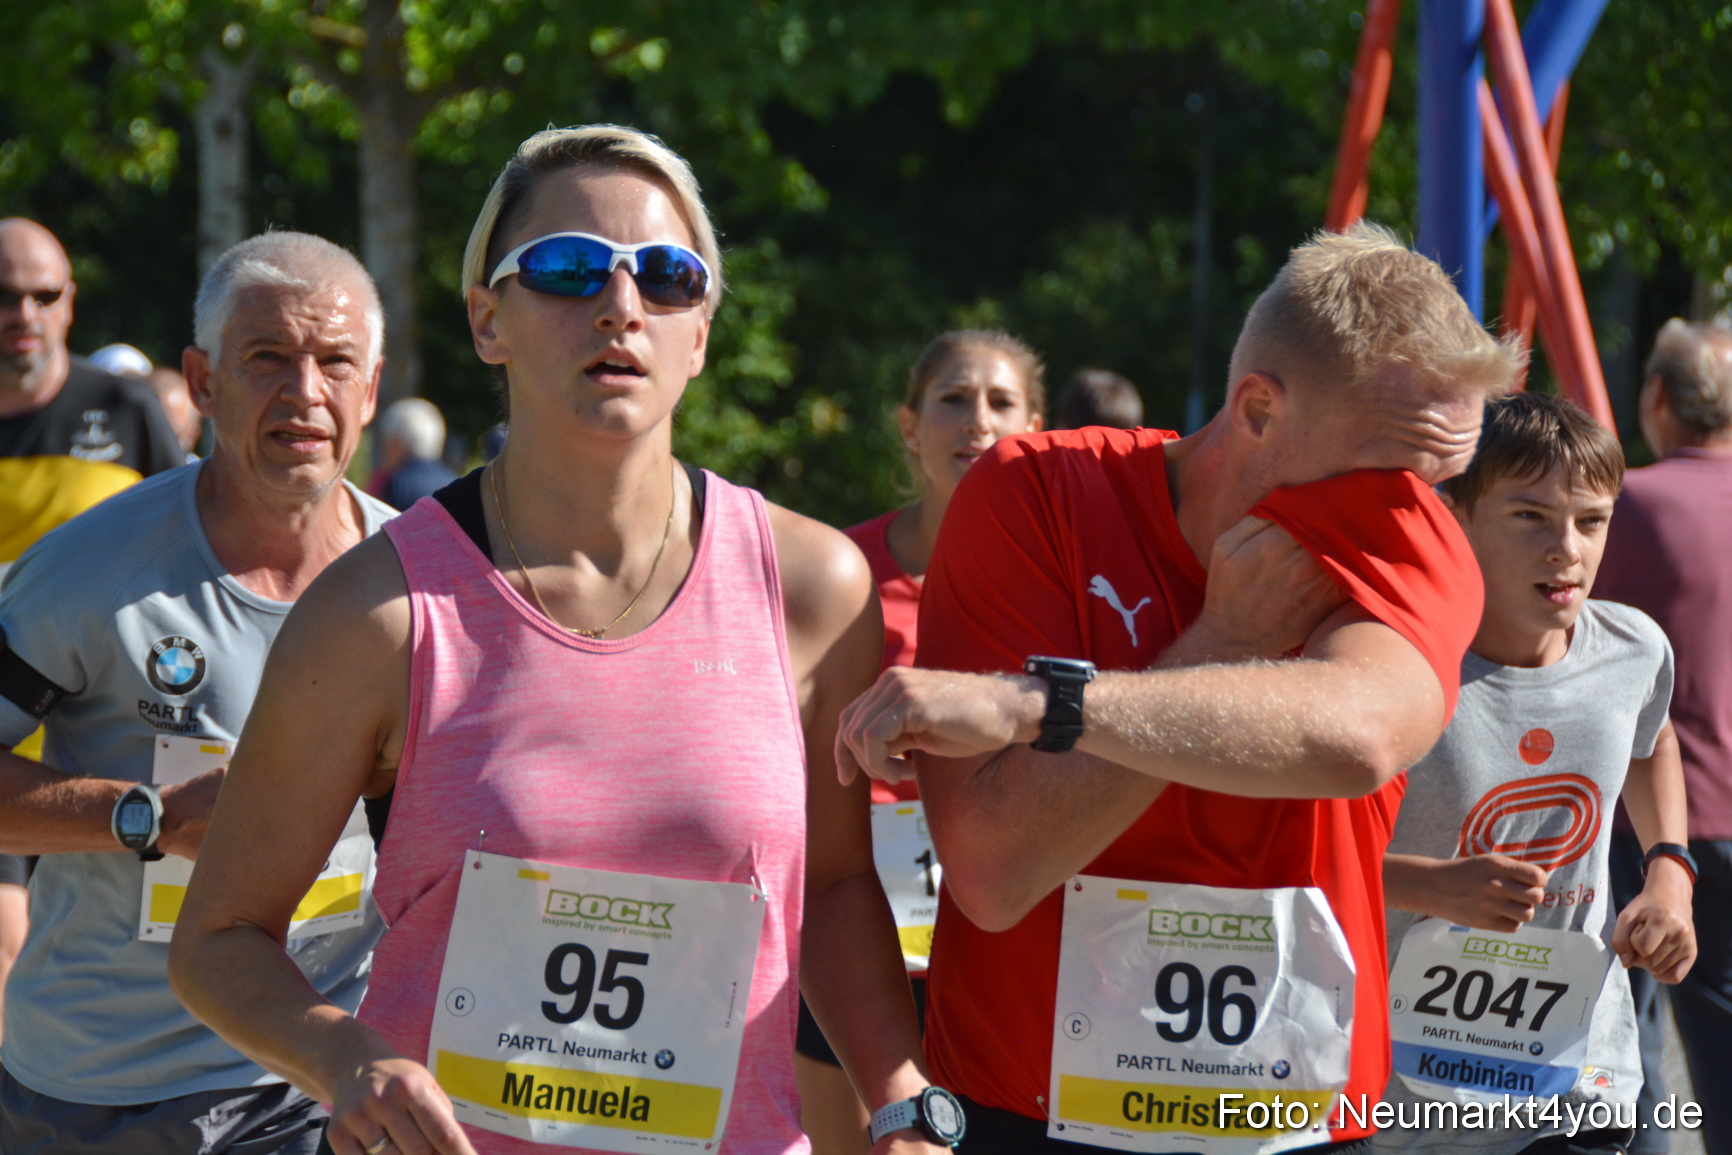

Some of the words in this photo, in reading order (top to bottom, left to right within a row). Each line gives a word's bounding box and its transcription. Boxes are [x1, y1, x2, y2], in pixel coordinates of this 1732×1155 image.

[153, 637, 204, 659] BMW
[138, 699, 198, 722] PARTL
[545, 888, 676, 930] BOCK
[1542, 883, 1596, 908] eisla
[542, 915, 582, 929] inspired
[584, 921, 595, 931] by
[598, 923, 626, 934] smart
[629, 927, 672, 940] concepts
[1148, 909, 1274, 942] BOCK
[1147, 937, 1185, 948] inspired
[1187, 939, 1198, 950] by
[1201, 942, 1229, 951] smart
[1232, 943, 1275, 953] concepts
[1463, 937, 1552, 965] BOCK
[541, 942, 649, 1030] 95
[1413, 966, 1569, 1032] 2047
[455, 995, 465, 1010] C
[1154, 961, 1257, 1046] 96
[1071, 1019, 1082, 1034] C
[1423, 1025, 1463, 1042] PARTL
[1466, 1033, 1525, 1053] Neumarkt
[498, 1033, 557, 1054] PARTL
[562, 1039, 648, 1065] Neumarkt
[1116, 1054, 1176, 1073] PARTL
[1182, 1058, 1265, 1077] Neumarkt
[1418, 1052, 1535, 1092] Korbinian
[501, 1072, 651, 1123] Manuela
